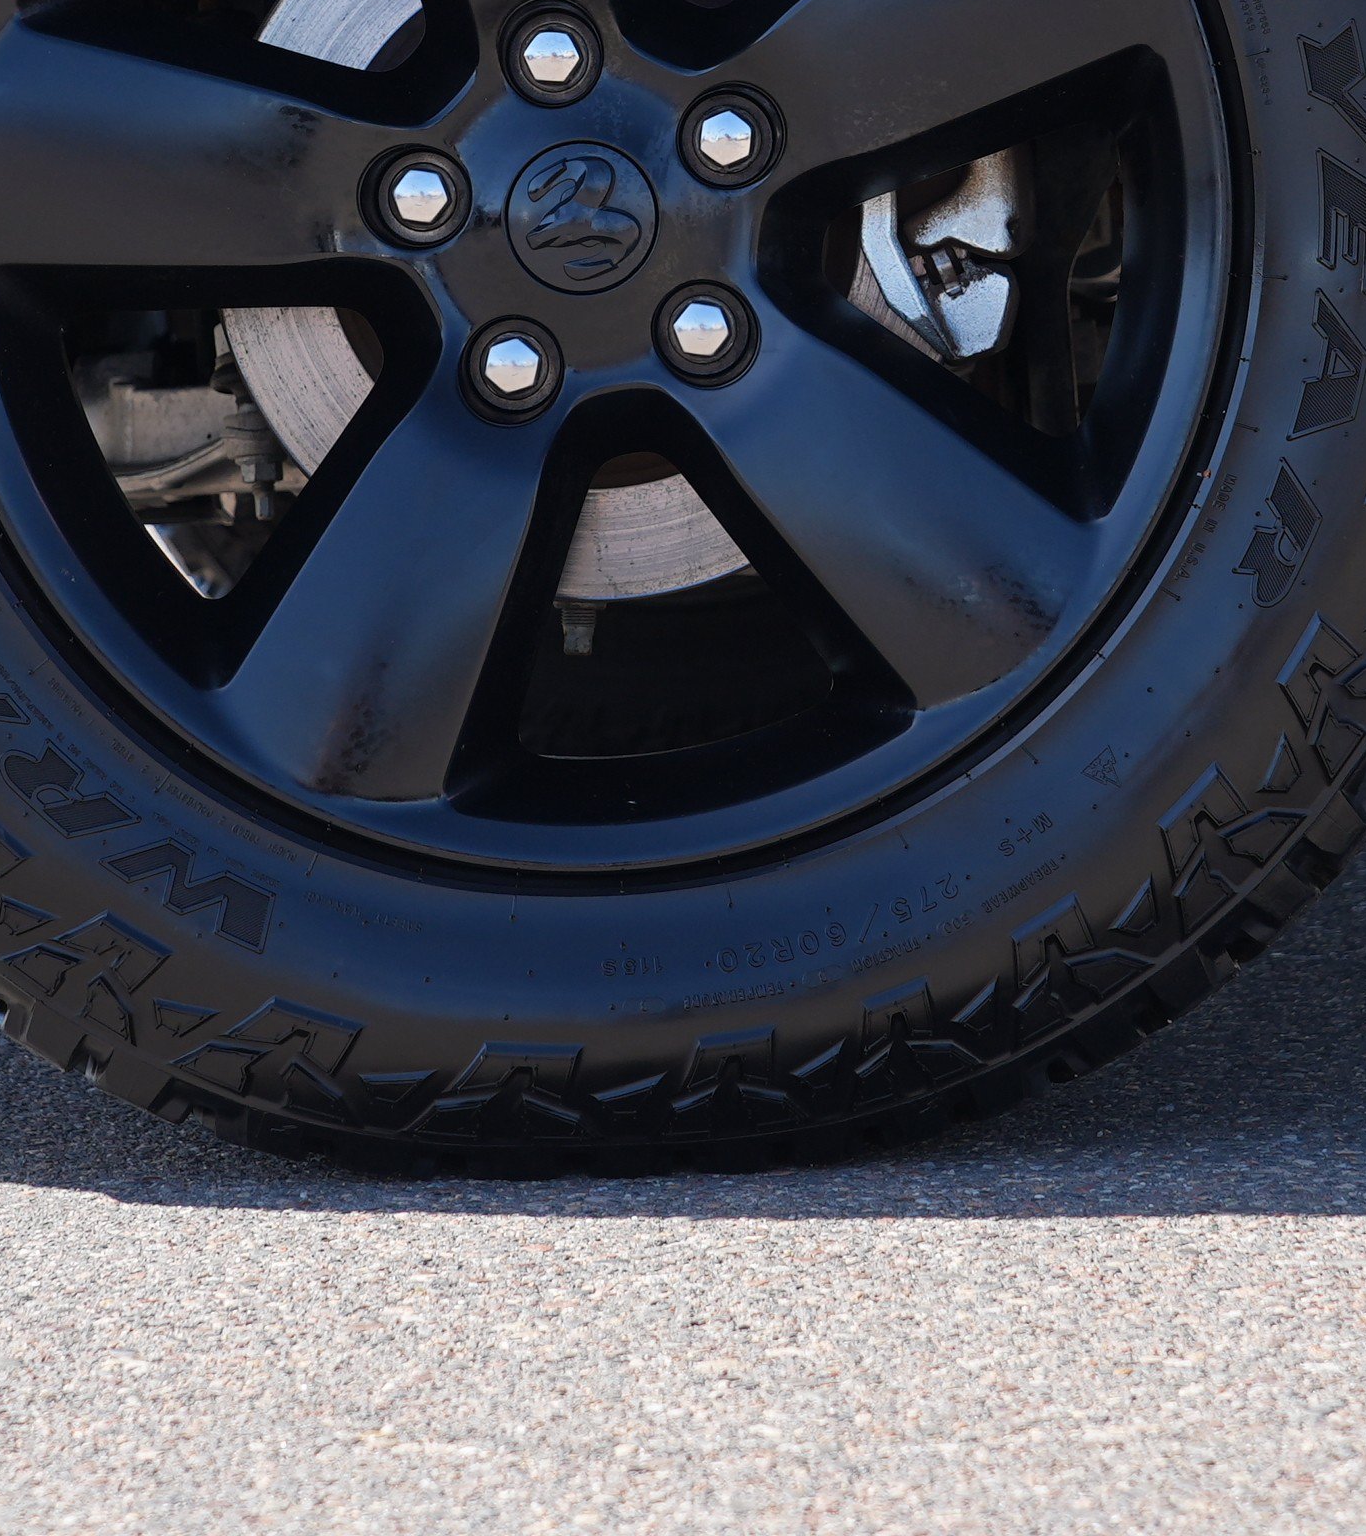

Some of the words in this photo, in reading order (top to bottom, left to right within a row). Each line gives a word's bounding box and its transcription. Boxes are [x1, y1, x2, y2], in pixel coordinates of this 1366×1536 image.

[1211, 471, 1237, 512] MADE
[1200, 516, 1218, 534] IN
[996, 809, 1055, 860] M+S
[714, 871, 961, 976] 275/60R20
